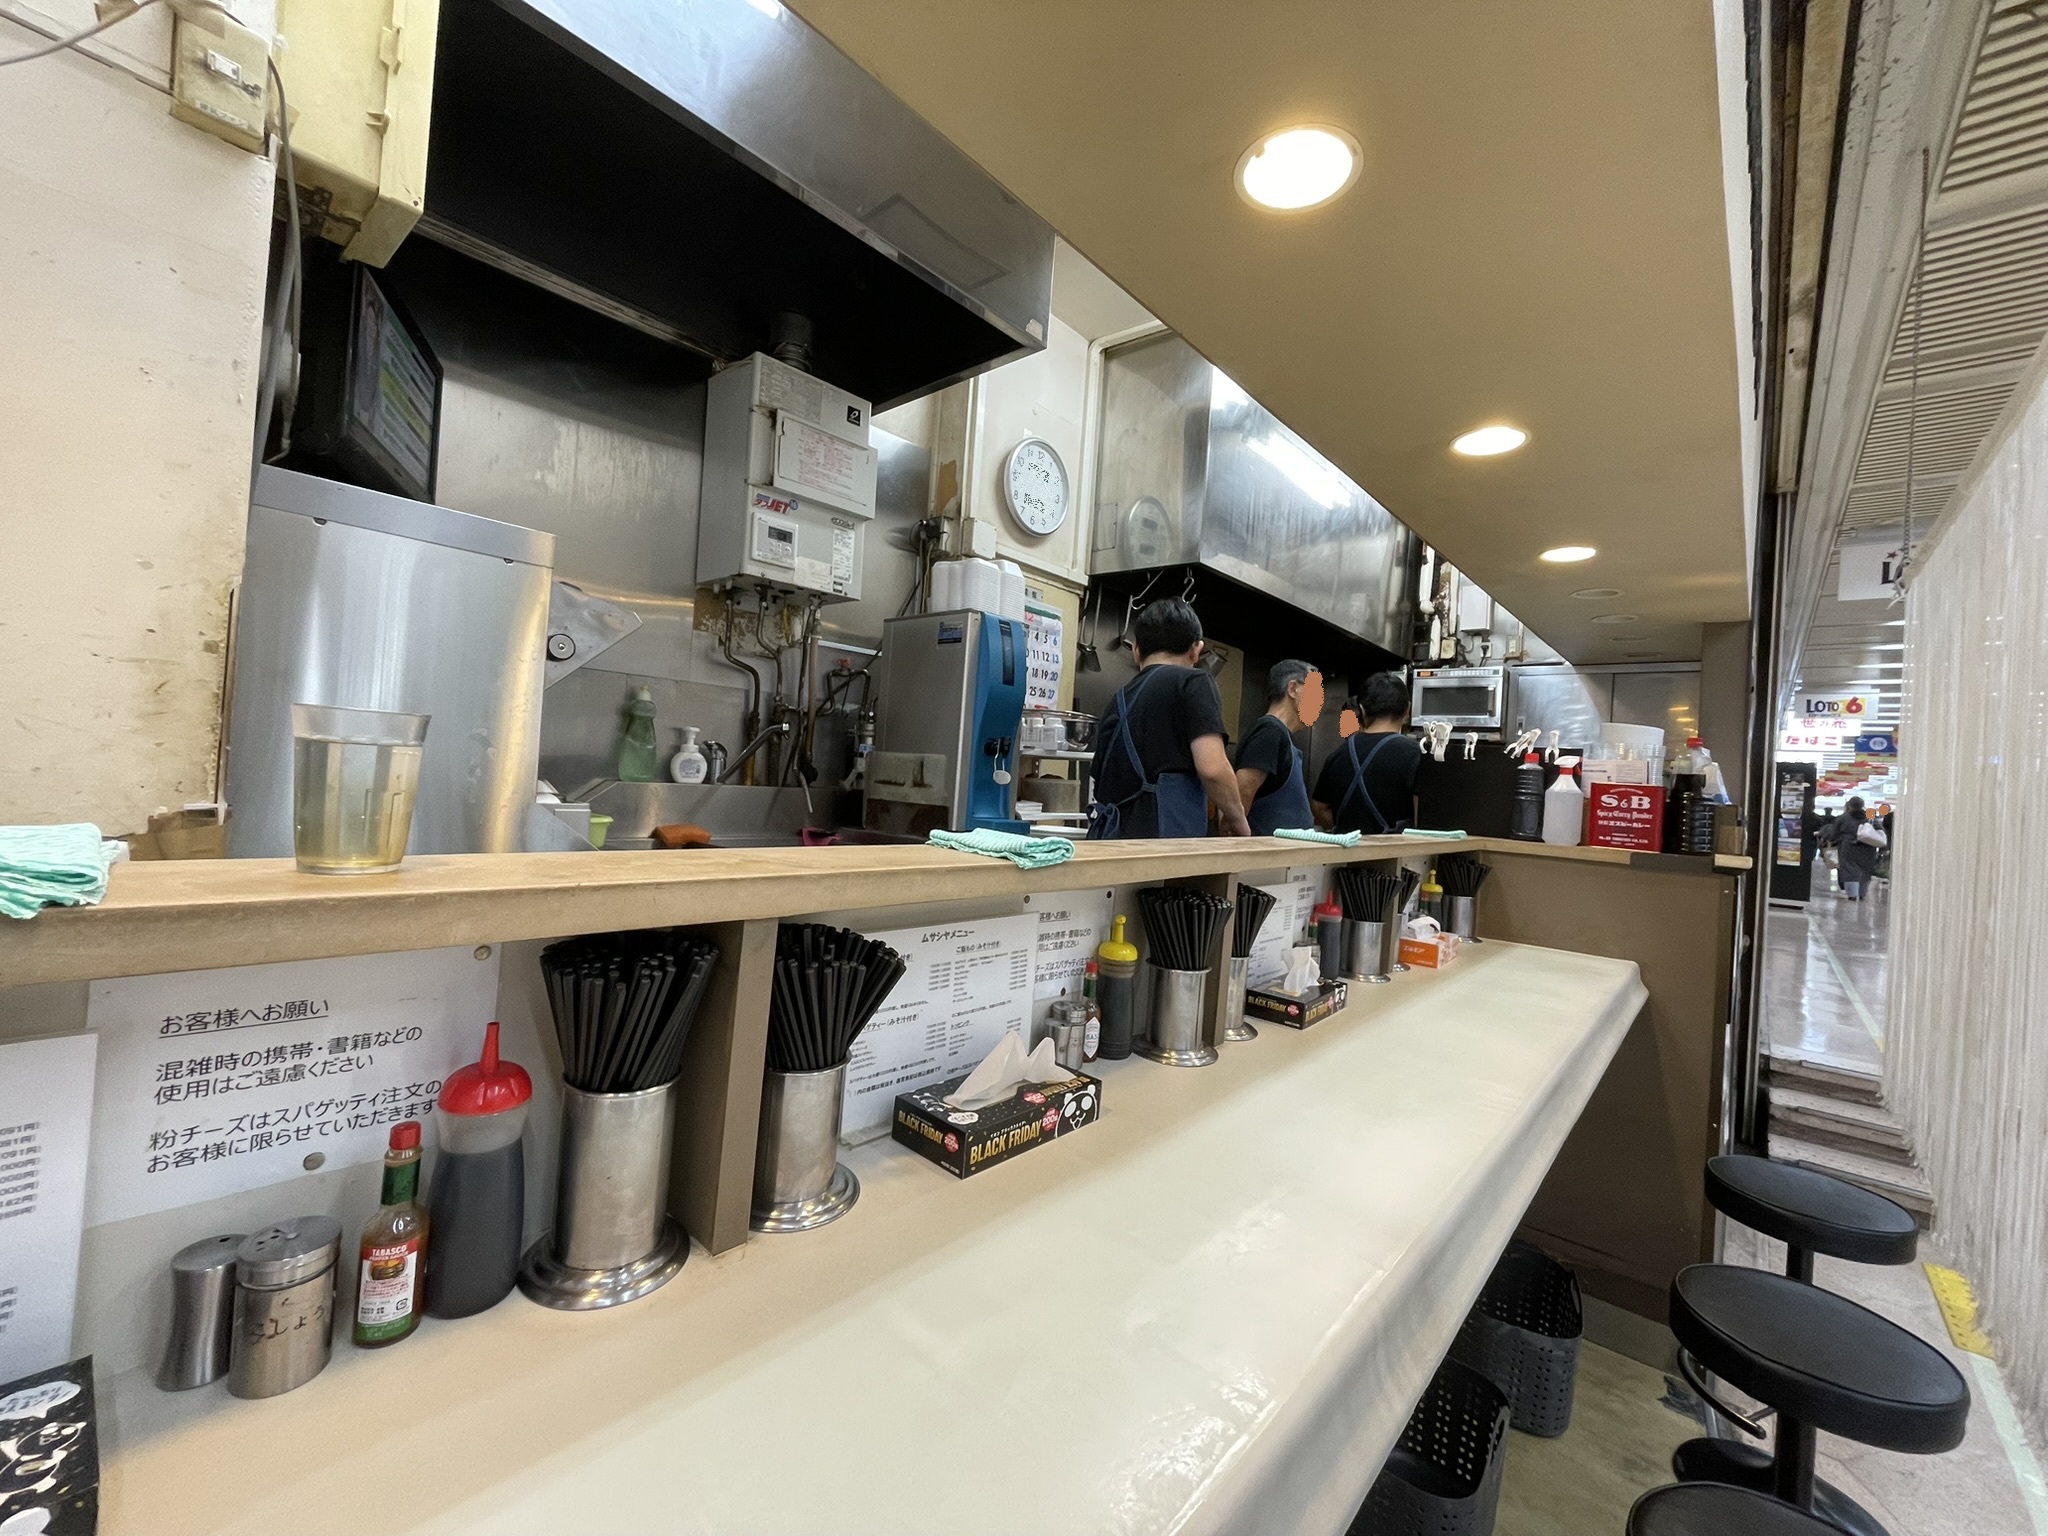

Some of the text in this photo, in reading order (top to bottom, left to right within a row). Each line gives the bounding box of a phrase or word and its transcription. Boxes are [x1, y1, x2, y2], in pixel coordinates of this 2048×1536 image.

[1034, 632, 1058, 646] 4 5 6
[1033, 650, 1059, 664] 11 12 13
[1032, 667, 1059, 681] 18 19 20
[1029, 686, 1055, 699] 25 26 27
[1806, 696, 1863, 714] LOTO 6
[1600, 794, 1651, 810] S&B
[1039, 910, 1071, 921] 客様へお願い
[921, 930, 975, 943] ムサシヤメニュー
[1038, 928, 1092, 942] 雑時の携帯・書籍などの
[1038, 940, 1079, 952] 用はご遠慮ください
[160, 1000, 329, 1034] お客様へお願い
[156, 1026, 423, 1082] 混雑時の携帯・書籍などの
[154, 1055, 374, 1105] 使用はご遠慮ください
[149, 1080, 442, 1150] 粉チーズはスパゲッティ注文の
[898, 1110, 944, 1144] BLACK FRIDAY
[147, 1098, 440, 1173] お客様に限らせていただきます
[969, 1119, 1042, 1165] BLACK FRIDAY
[372, 1244, 407, 1256] TABASCO
